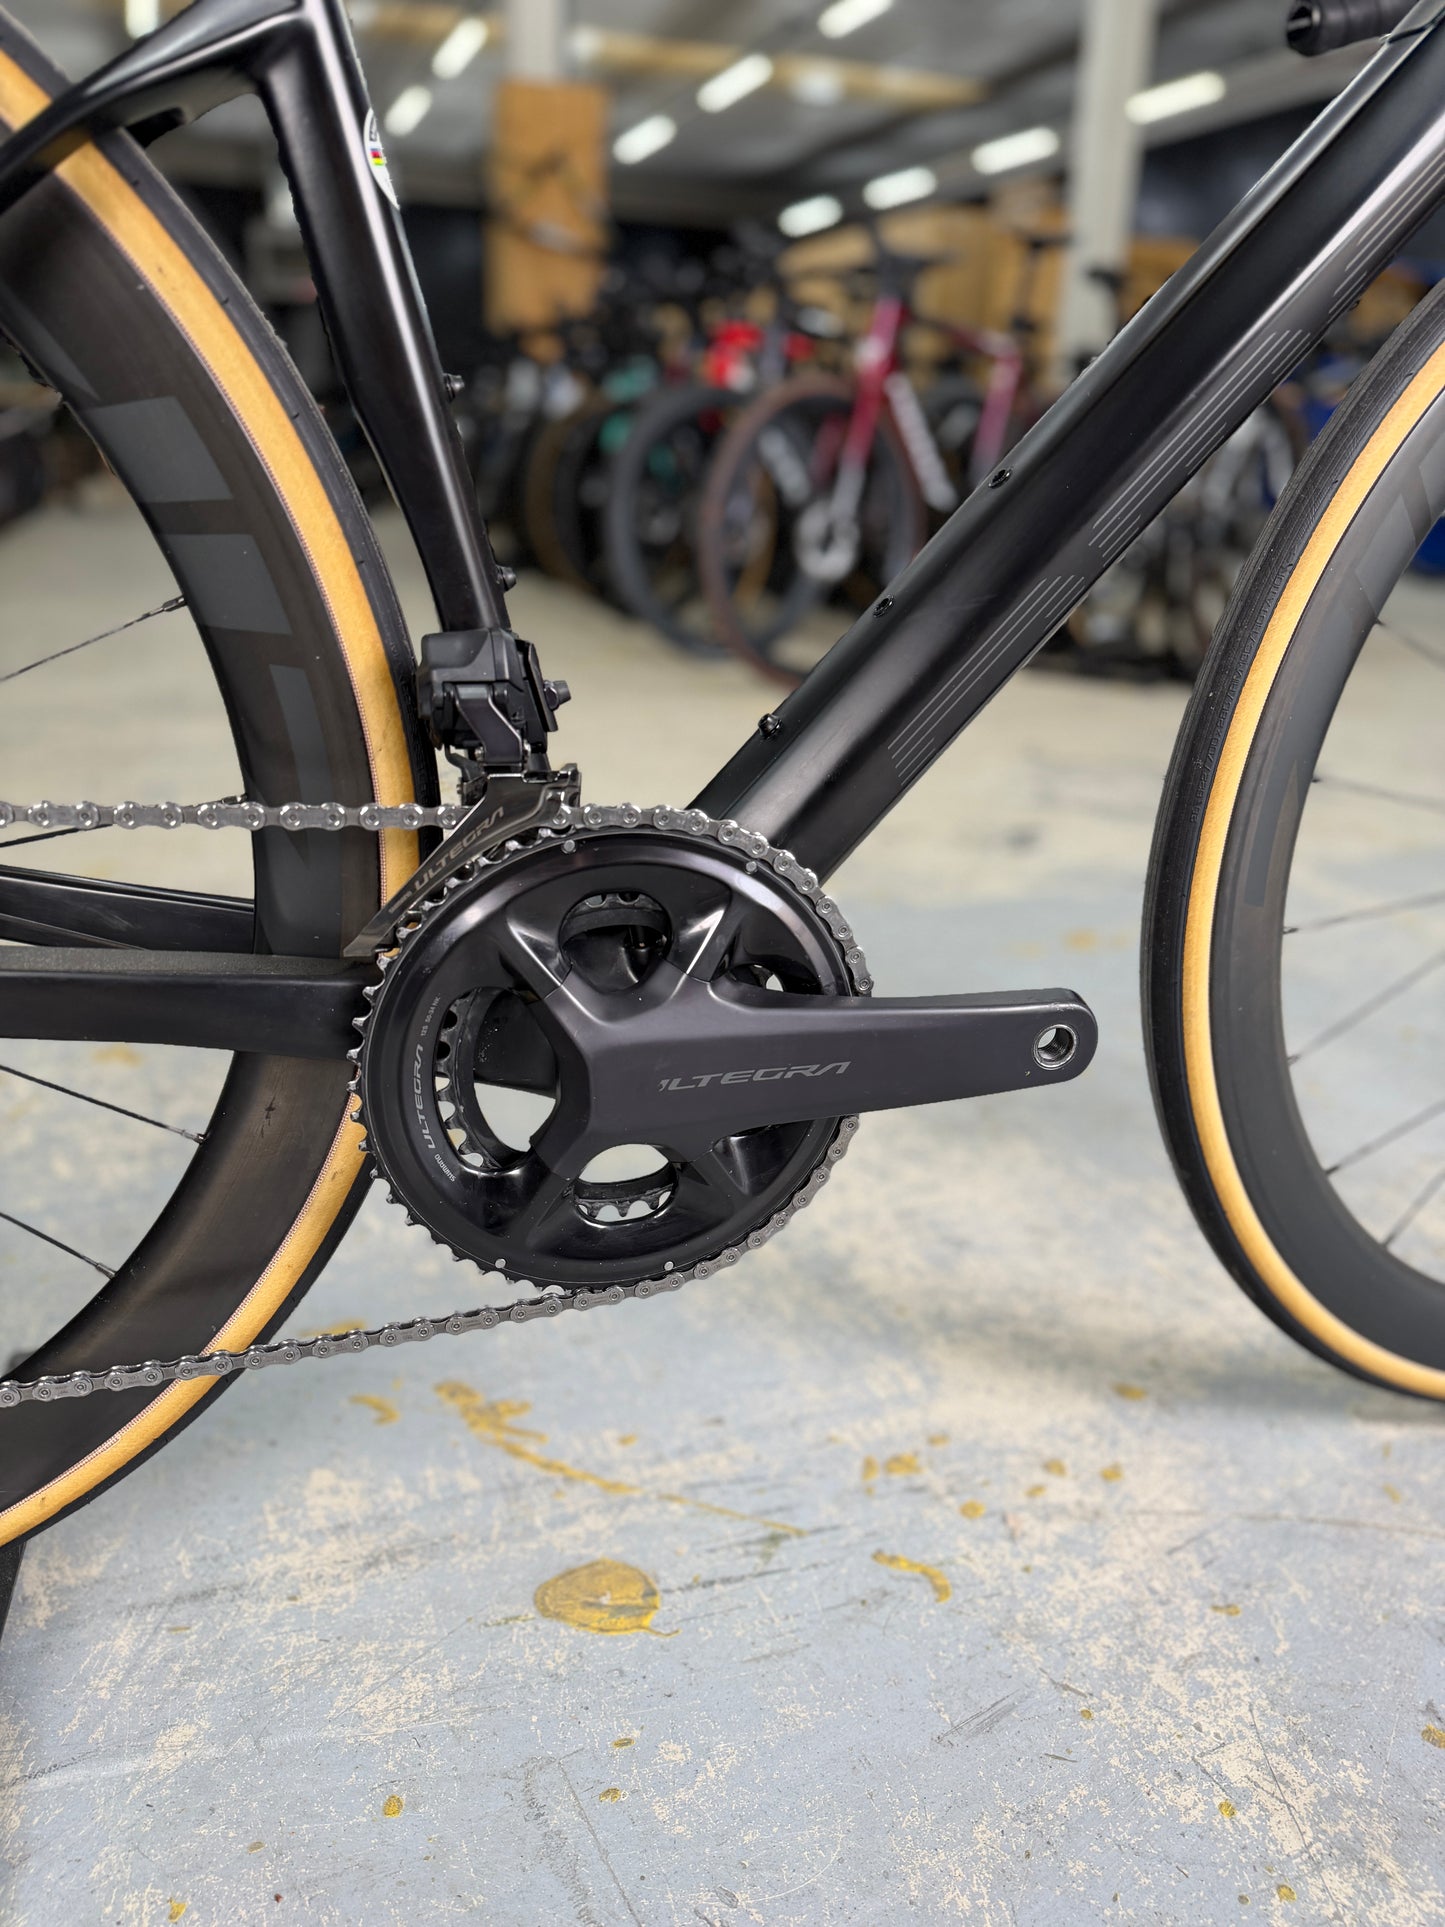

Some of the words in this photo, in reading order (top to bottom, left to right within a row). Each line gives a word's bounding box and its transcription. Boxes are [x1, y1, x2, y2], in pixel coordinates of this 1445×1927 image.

[415, 806, 505, 891] ULTEGRA
[413, 1044, 436, 1149] ULTEGRA
[435, 1154, 456, 1182] SHIMANO
